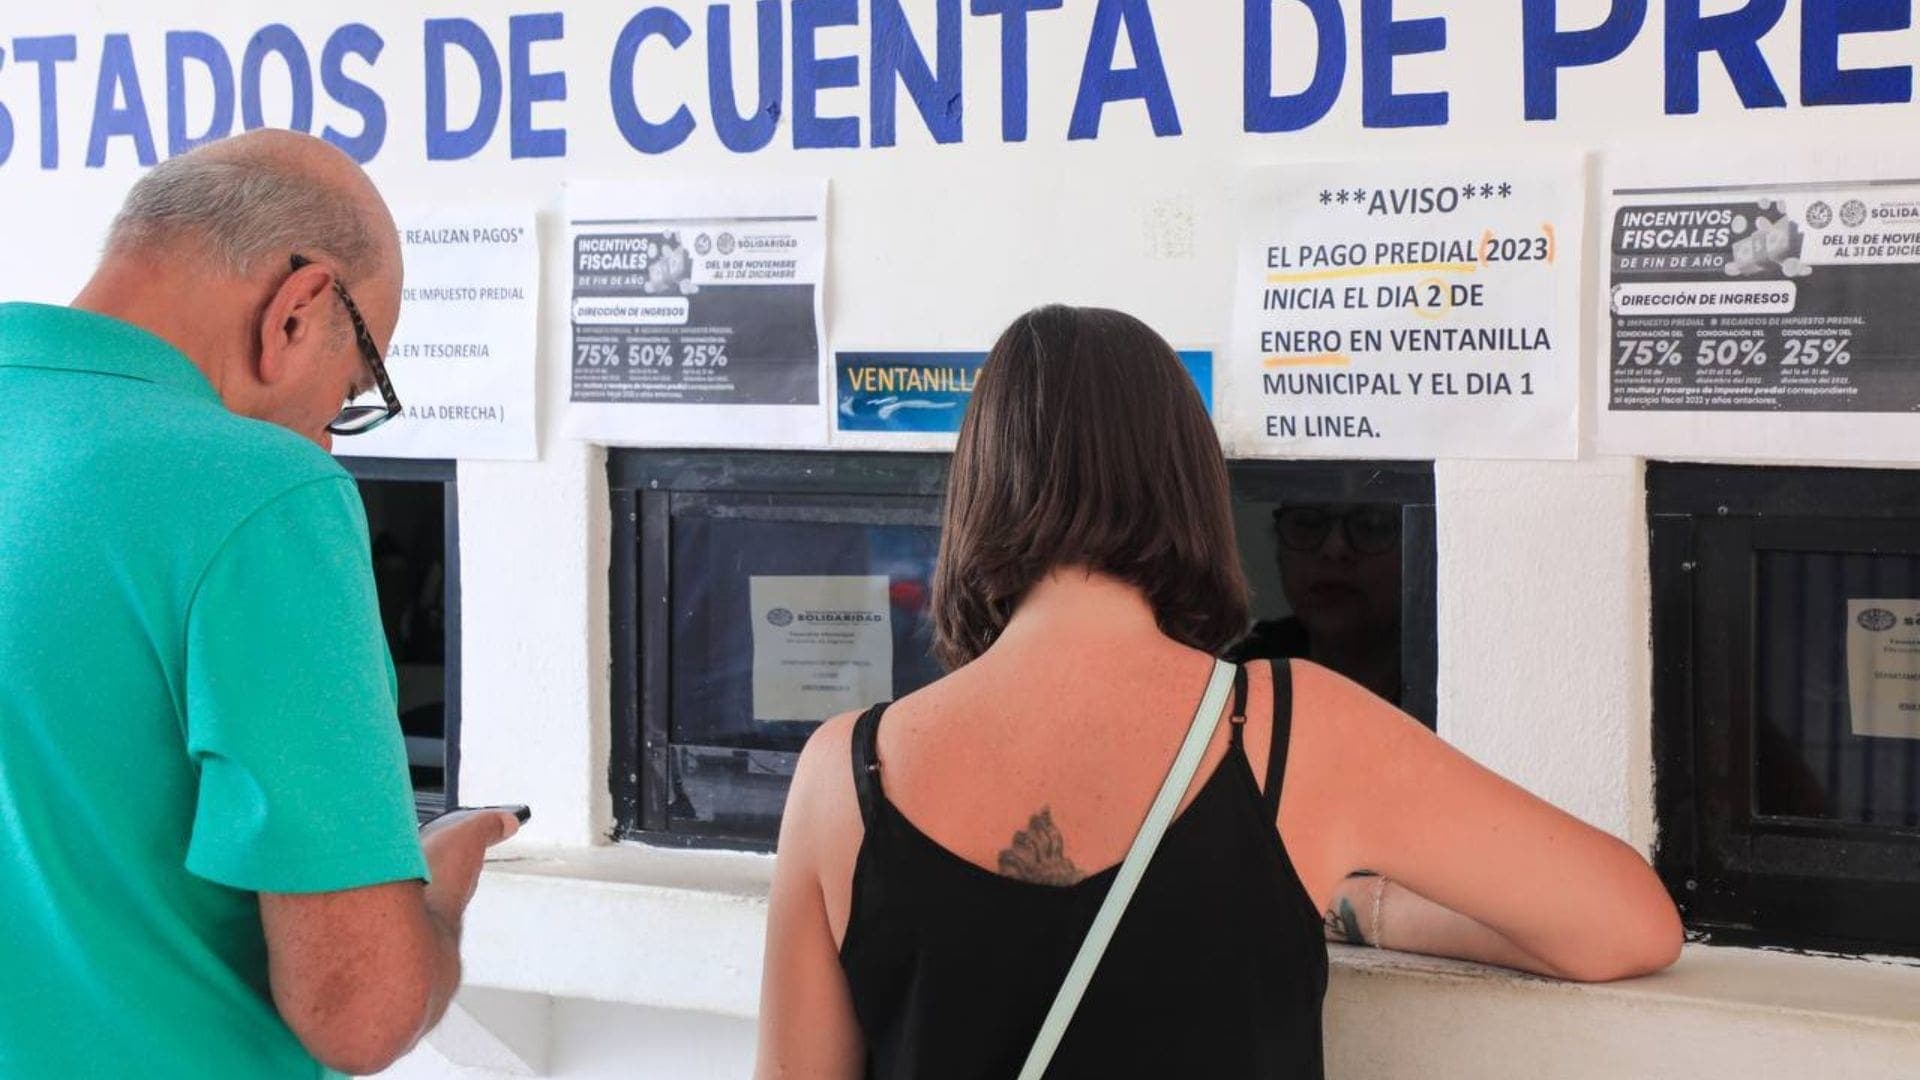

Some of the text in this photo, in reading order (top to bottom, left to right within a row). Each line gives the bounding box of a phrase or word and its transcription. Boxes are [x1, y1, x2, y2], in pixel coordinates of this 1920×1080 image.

[0, 23, 386, 170] TADOS
[425, 13, 566, 160] DE
[610, 0, 1183, 154] CUENTA
[1243, 0, 1448, 132] DE
[1622, 209, 1732, 227] INCENTIVOS
[406, 229, 469, 244] REALIZAN
[579, 238, 648, 252] INCENTIVOS
[1621, 228, 1730, 249] FISCALES
[1822, 234, 1845, 246] DEL
[1847, 234, 1859, 244] 18
[1862, 234, 1879, 244] DE
[1267, 246, 1291, 268] EL
[1299, 244, 1367, 267] PAGO
[1375, 240, 1478, 265] PREDIAL
[1835, 246, 1849, 257] AL
[1853, 246, 1865, 256] 31
[1867, 246, 1883, 256] DE
[580, 253, 647, 270] FISCALES
[1620, 254, 1724, 268] DE FIN DE AÑO
[403, 287, 524, 301] DE IMPUESTO PREDIAL
[1263, 284, 1484, 310] INICIA EL DIA 2 DE
[1621, 291, 1789, 306] DIRECCIÓN DE INGRESOS
[1260, 327, 1551, 353] ENERO EN VENTANILLA
[404, 344, 418, 357] EN
[577, 344, 728, 367] 75% 50% 25%
[1618, 339, 1851, 366] 75% 50% 25%
[1263, 373, 1534, 395] MUNICIPAL Y EL DIA 1
[409, 406, 417, 419] A
[421, 406, 435, 419] LA
[439, 406, 497, 420] DERECHA
[1266, 415, 1381, 438] EN LINEA.
